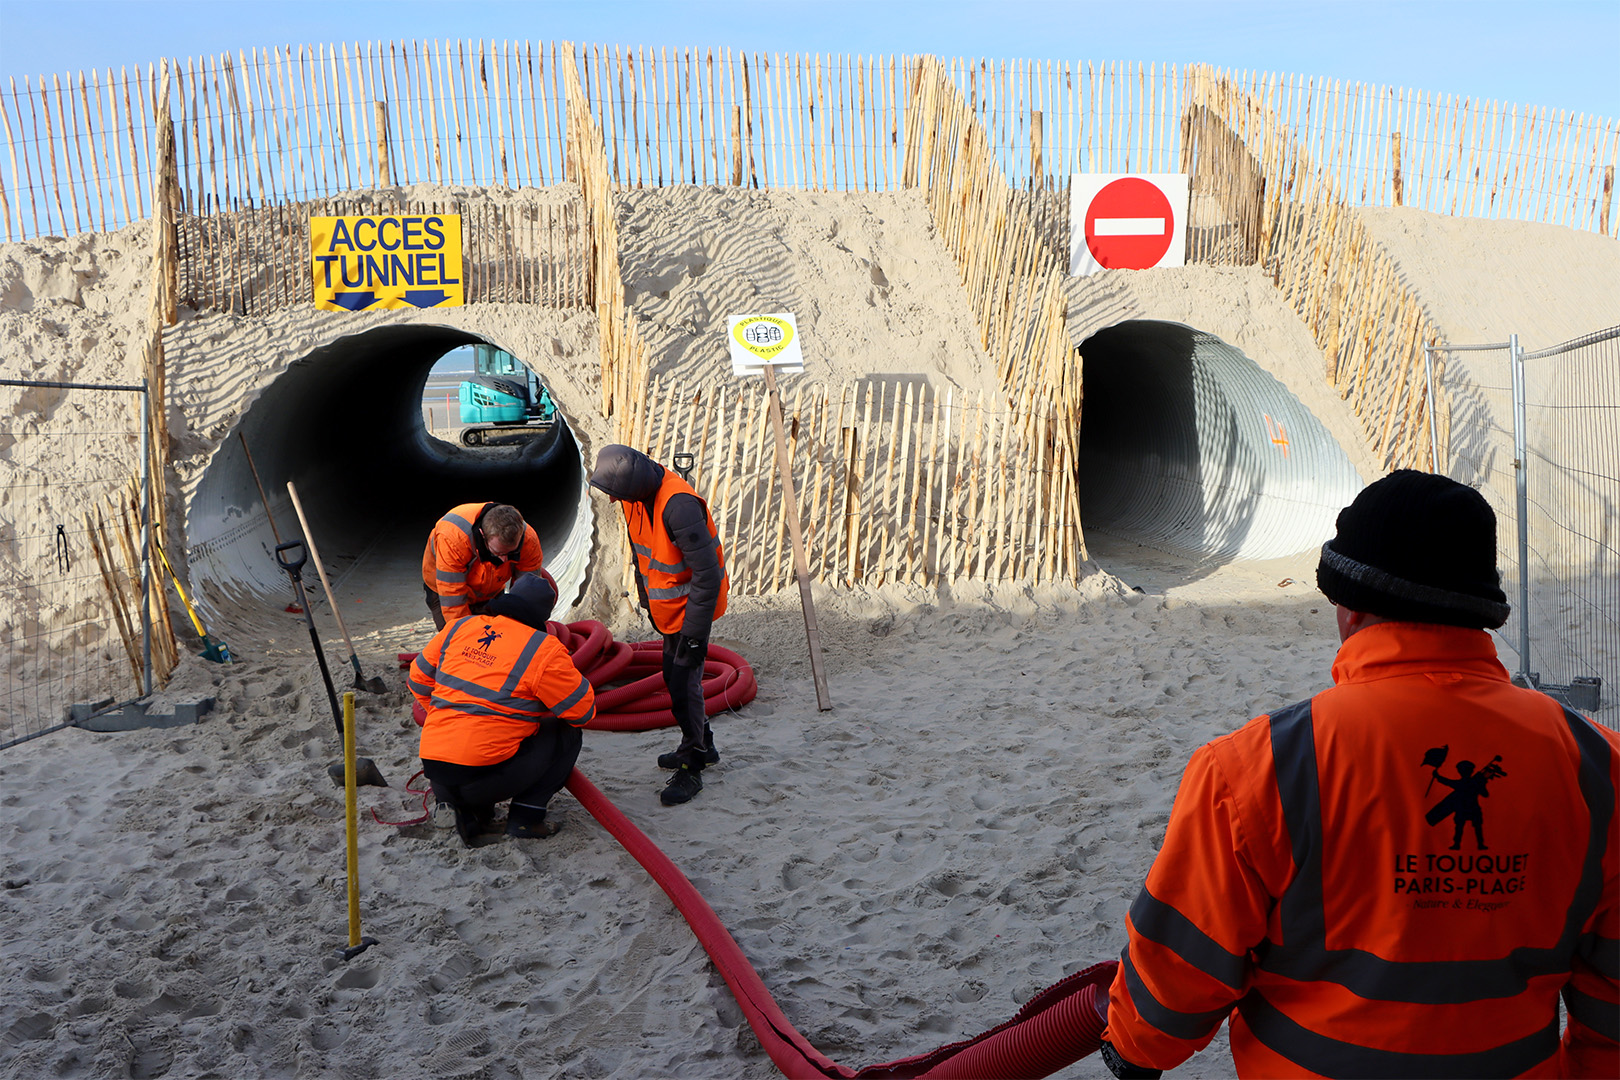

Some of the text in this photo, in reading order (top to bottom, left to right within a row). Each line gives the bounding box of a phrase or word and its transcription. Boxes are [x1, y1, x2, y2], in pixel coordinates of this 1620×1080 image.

[329, 217, 445, 252] ACCES
[315, 253, 460, 288] TUNNEL
[740, 316, 783, 327] PLASTIQUE
[749, 345, 784, 353] PLASTIC
[470, 648, 497, 661] TOUQUET
[1395, 853, 1529, 874] LE TOUQUET
[1394, 876, 1526, 895] PARIS-PLAGE
[1412, 899, 1449, 910] Nature
[1451, 898, 1463, 910] &
